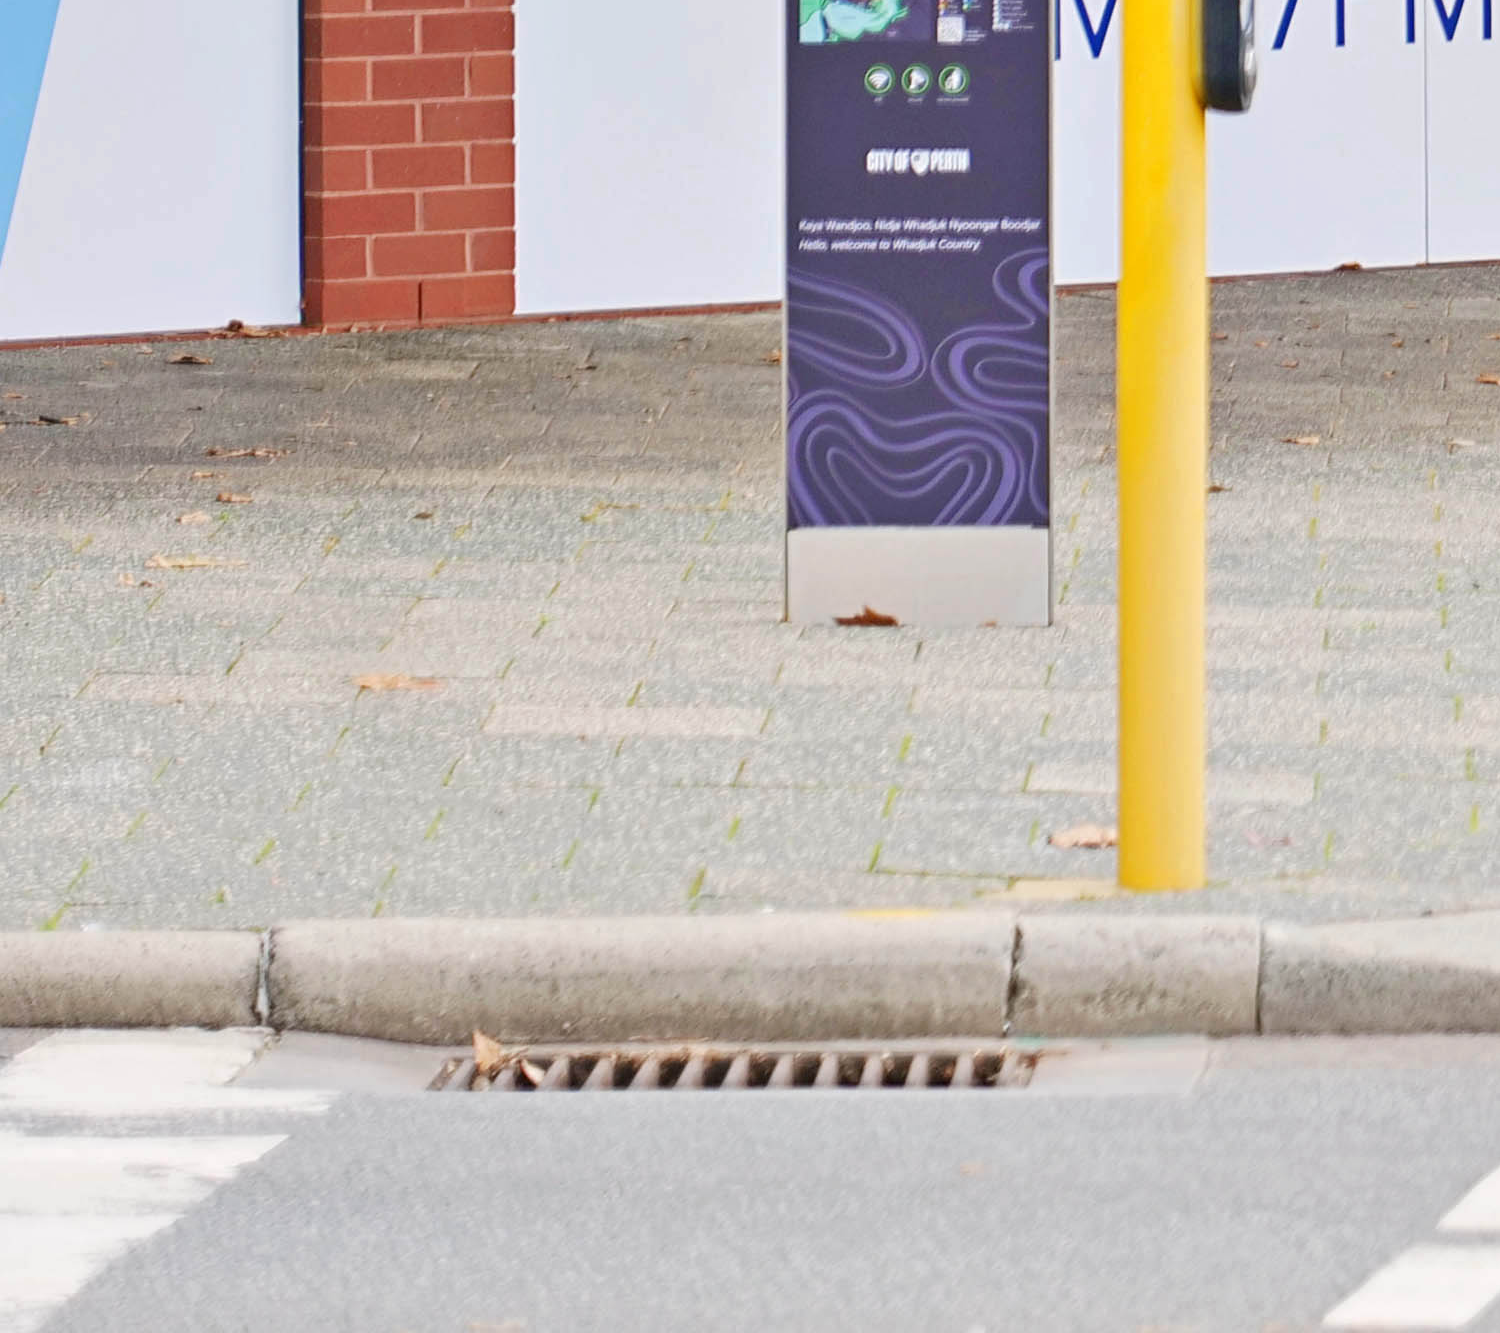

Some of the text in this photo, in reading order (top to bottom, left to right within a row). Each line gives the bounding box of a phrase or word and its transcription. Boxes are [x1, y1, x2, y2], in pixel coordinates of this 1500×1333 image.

[866, 148, 971, 174] CITY OF PERTH
[798, 219, 824, 234] Kaya
[874, 219, 901, 234] Nidja
[903, 219, 947, 234] Whadjuk
[949, 219, 999, 234] Nyoongar
[831, 238, 876, 252] welcome
[879, 238, 890, 252] to
[892, 238, 937, 252] Whadjuk
[938, 238, 982, 252] Country
